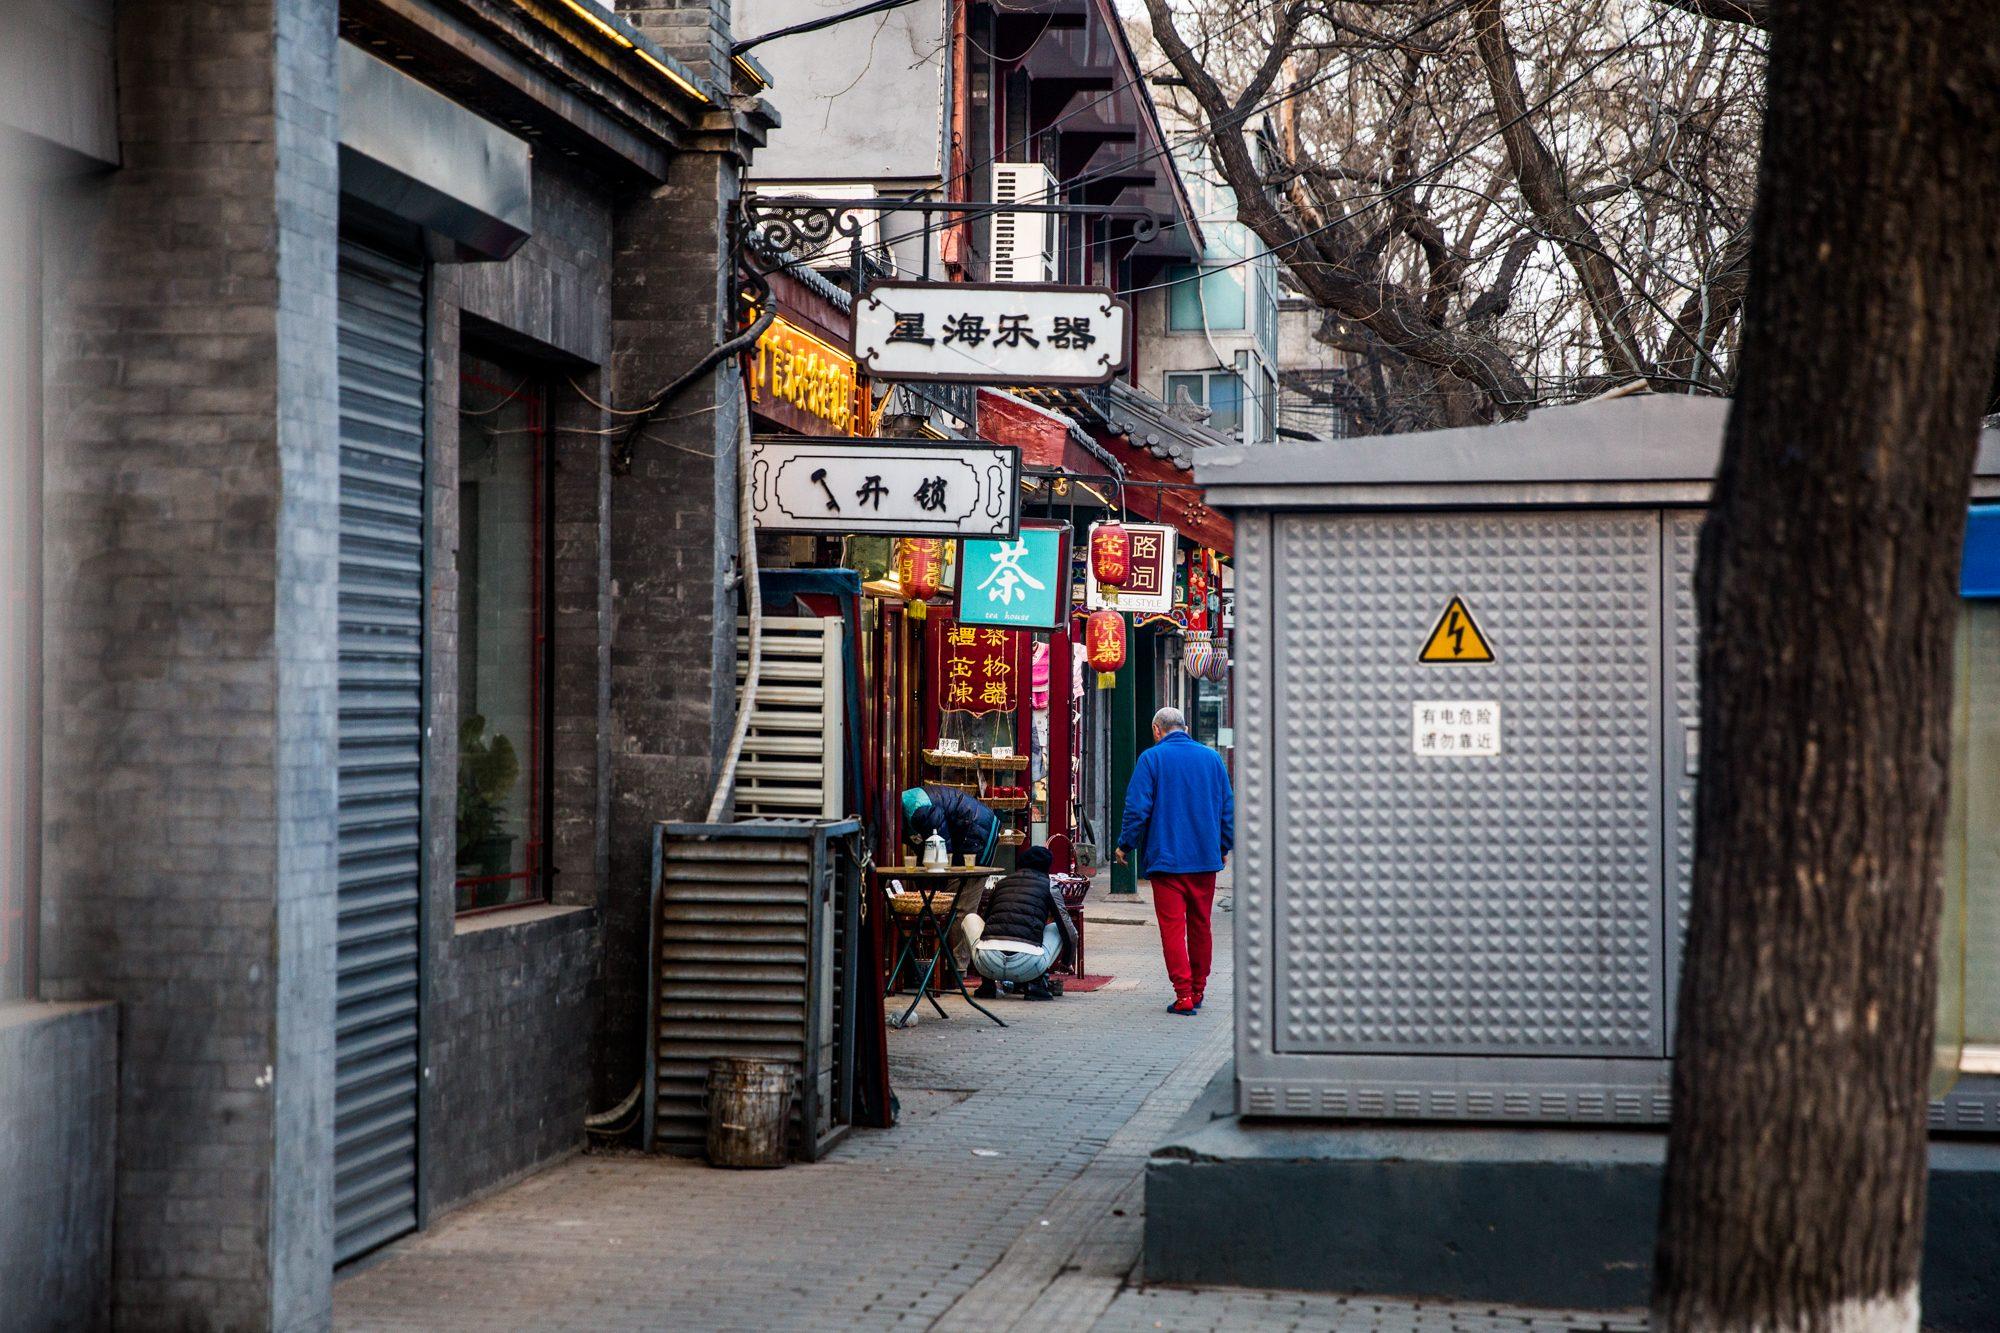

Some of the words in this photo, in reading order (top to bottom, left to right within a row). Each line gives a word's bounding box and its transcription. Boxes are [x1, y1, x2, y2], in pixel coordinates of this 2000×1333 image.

[885, 311, 1096, 350] 星海乐器
[855, 474, 948, 512] 开锁
[977, 537, 1045, 605] 茶
[1135, 598, 1162, 609] STYLE
[985, 611, 998, 619] tea
[1004, 611, 1030, 621] house
[1422, 708, 1491, 725] 有电危险
[1421, 732, 1491, 749] 请勿靠近
